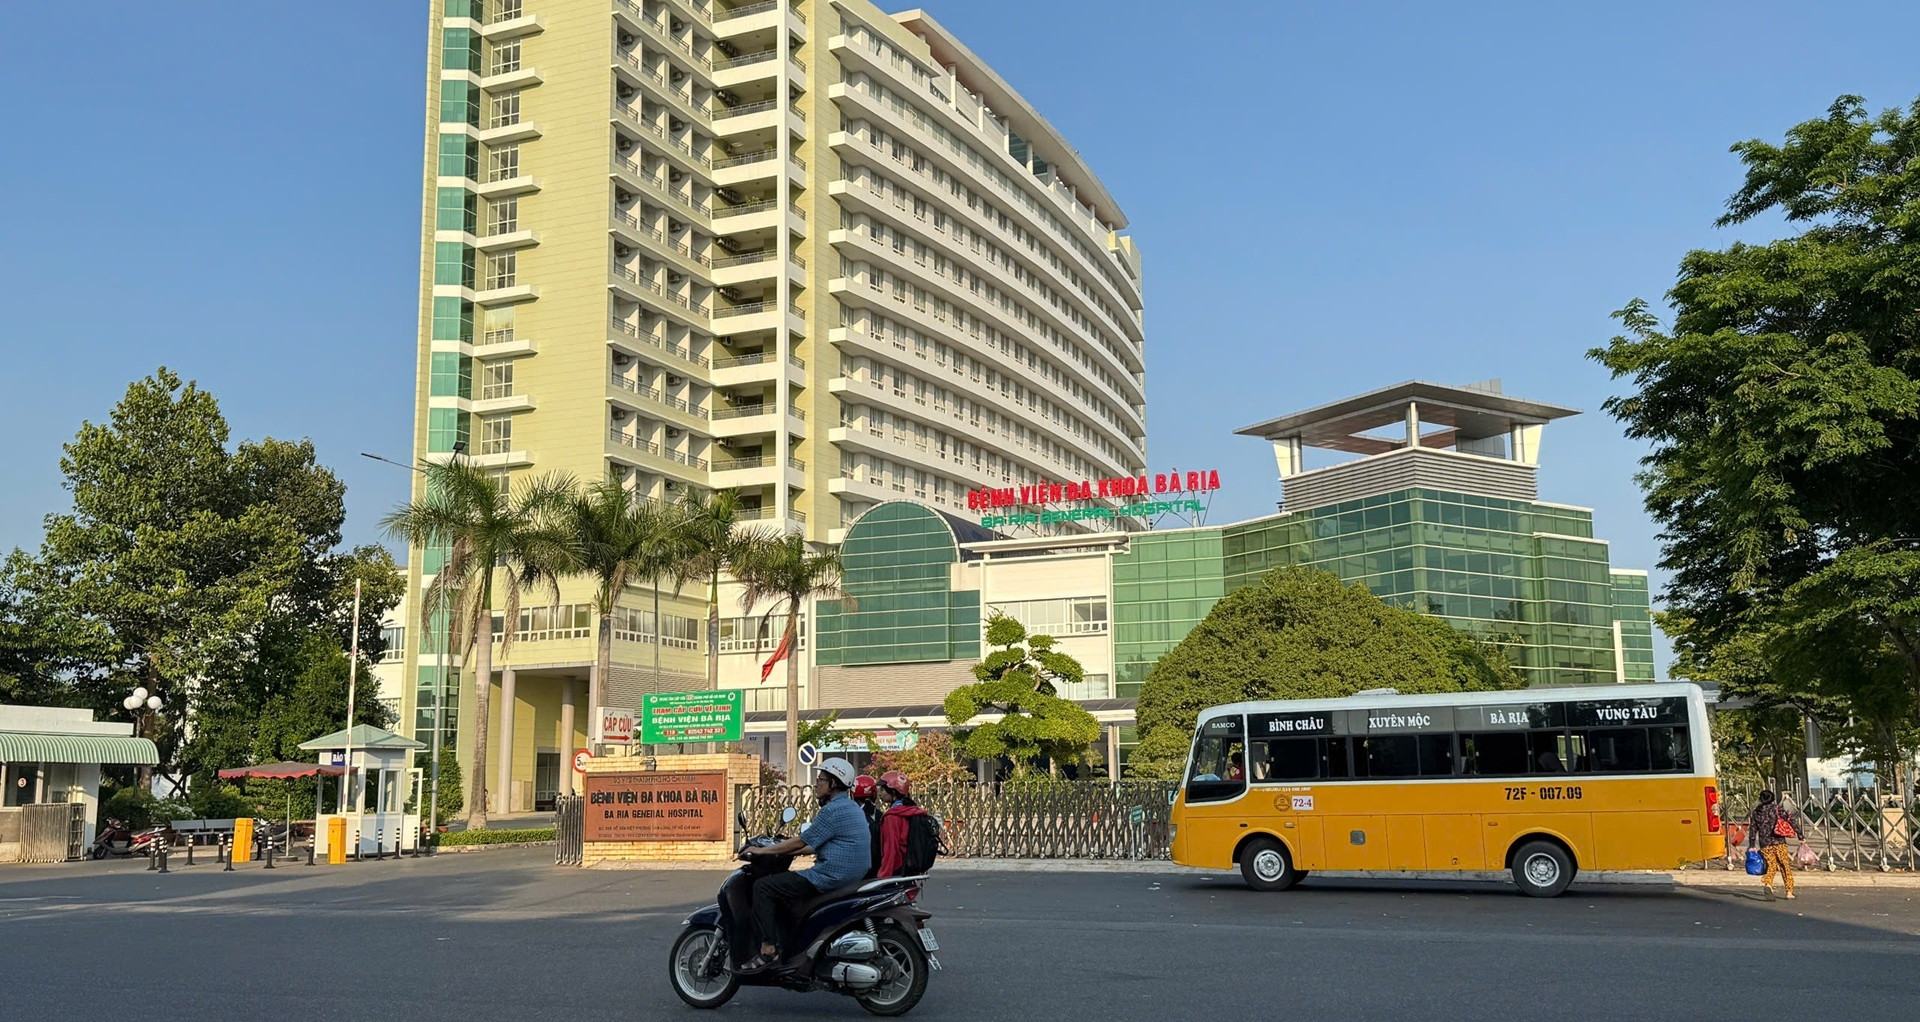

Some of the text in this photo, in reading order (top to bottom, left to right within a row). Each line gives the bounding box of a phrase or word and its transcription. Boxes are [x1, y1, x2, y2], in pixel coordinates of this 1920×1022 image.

[968, 485, 1014, 512] BỆNH
[1020, 479, 1062, 507] VIỆN
[1098, 475, 1149, 498] KHOA
[1155, 467, 1182, 493] BÀ
[1187, 469, 1220, 495] RỊA
[981, 499, 1206, 528] BA RIA GENERAL HOSPITAL
[652, 714, 731, 725] BỆNH VIỆN BÀ RỊA
[1490, 709, 1529, 726] BÀ RỊA
[1596, 704, 1658, 720] VŨNG TÀU
[603, 711, 617, 731] CẤP
[1269, 716, 1324, 732] BÌNH CHÂU
[1369, 712, 1430, 729] XUYÊN MỘC
[591, 789, 614, 806] BỆNH
[617, 789, 638, 806] VIỆN
[656, 790, 683, 803] KHOA
[685, 787, 699, 803] BÀ
[701, 790, 718, 805] RỊA
[1505, 787, 1527, 800] 72F
[1540, 786, 1582, 800] 007.09
[1293, 798, 1312, 807] 72-4
[604, 809, 704, 819] BA RIA GENERAL HOSPITAL
